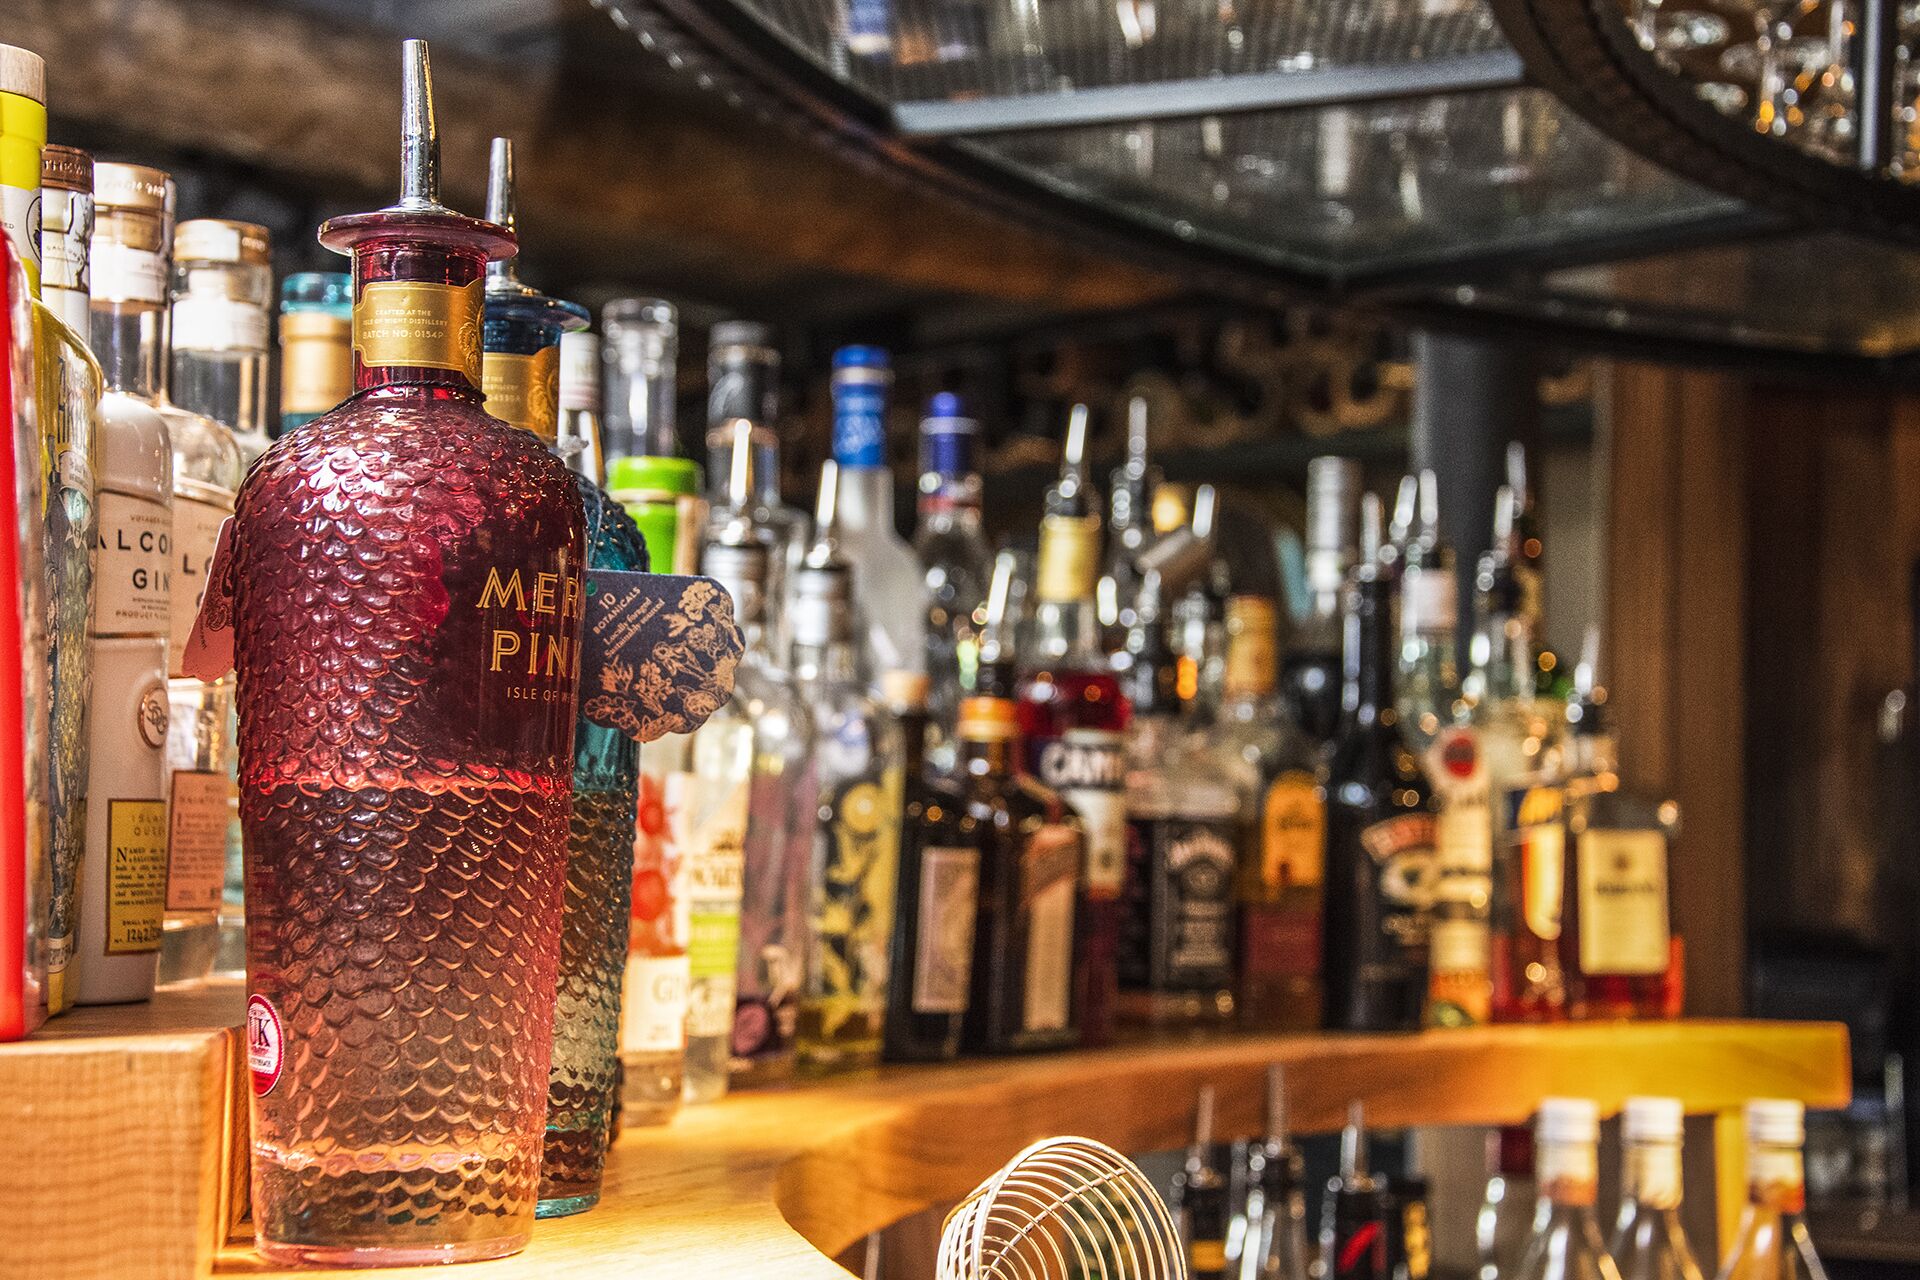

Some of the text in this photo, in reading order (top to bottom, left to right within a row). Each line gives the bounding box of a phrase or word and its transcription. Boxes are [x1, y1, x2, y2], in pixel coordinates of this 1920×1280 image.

[409, 318, 448, 327] DISTILLERY
[362, 330, 389, 339] BATCH
[392, 329, 412, 339] NO:
[598, 592, 616, 610] 10
[593, 586, 641, 635] BOTANICALS
[507, 686, 537, 701] ISLE
[543, 690, 558, 701] OF
